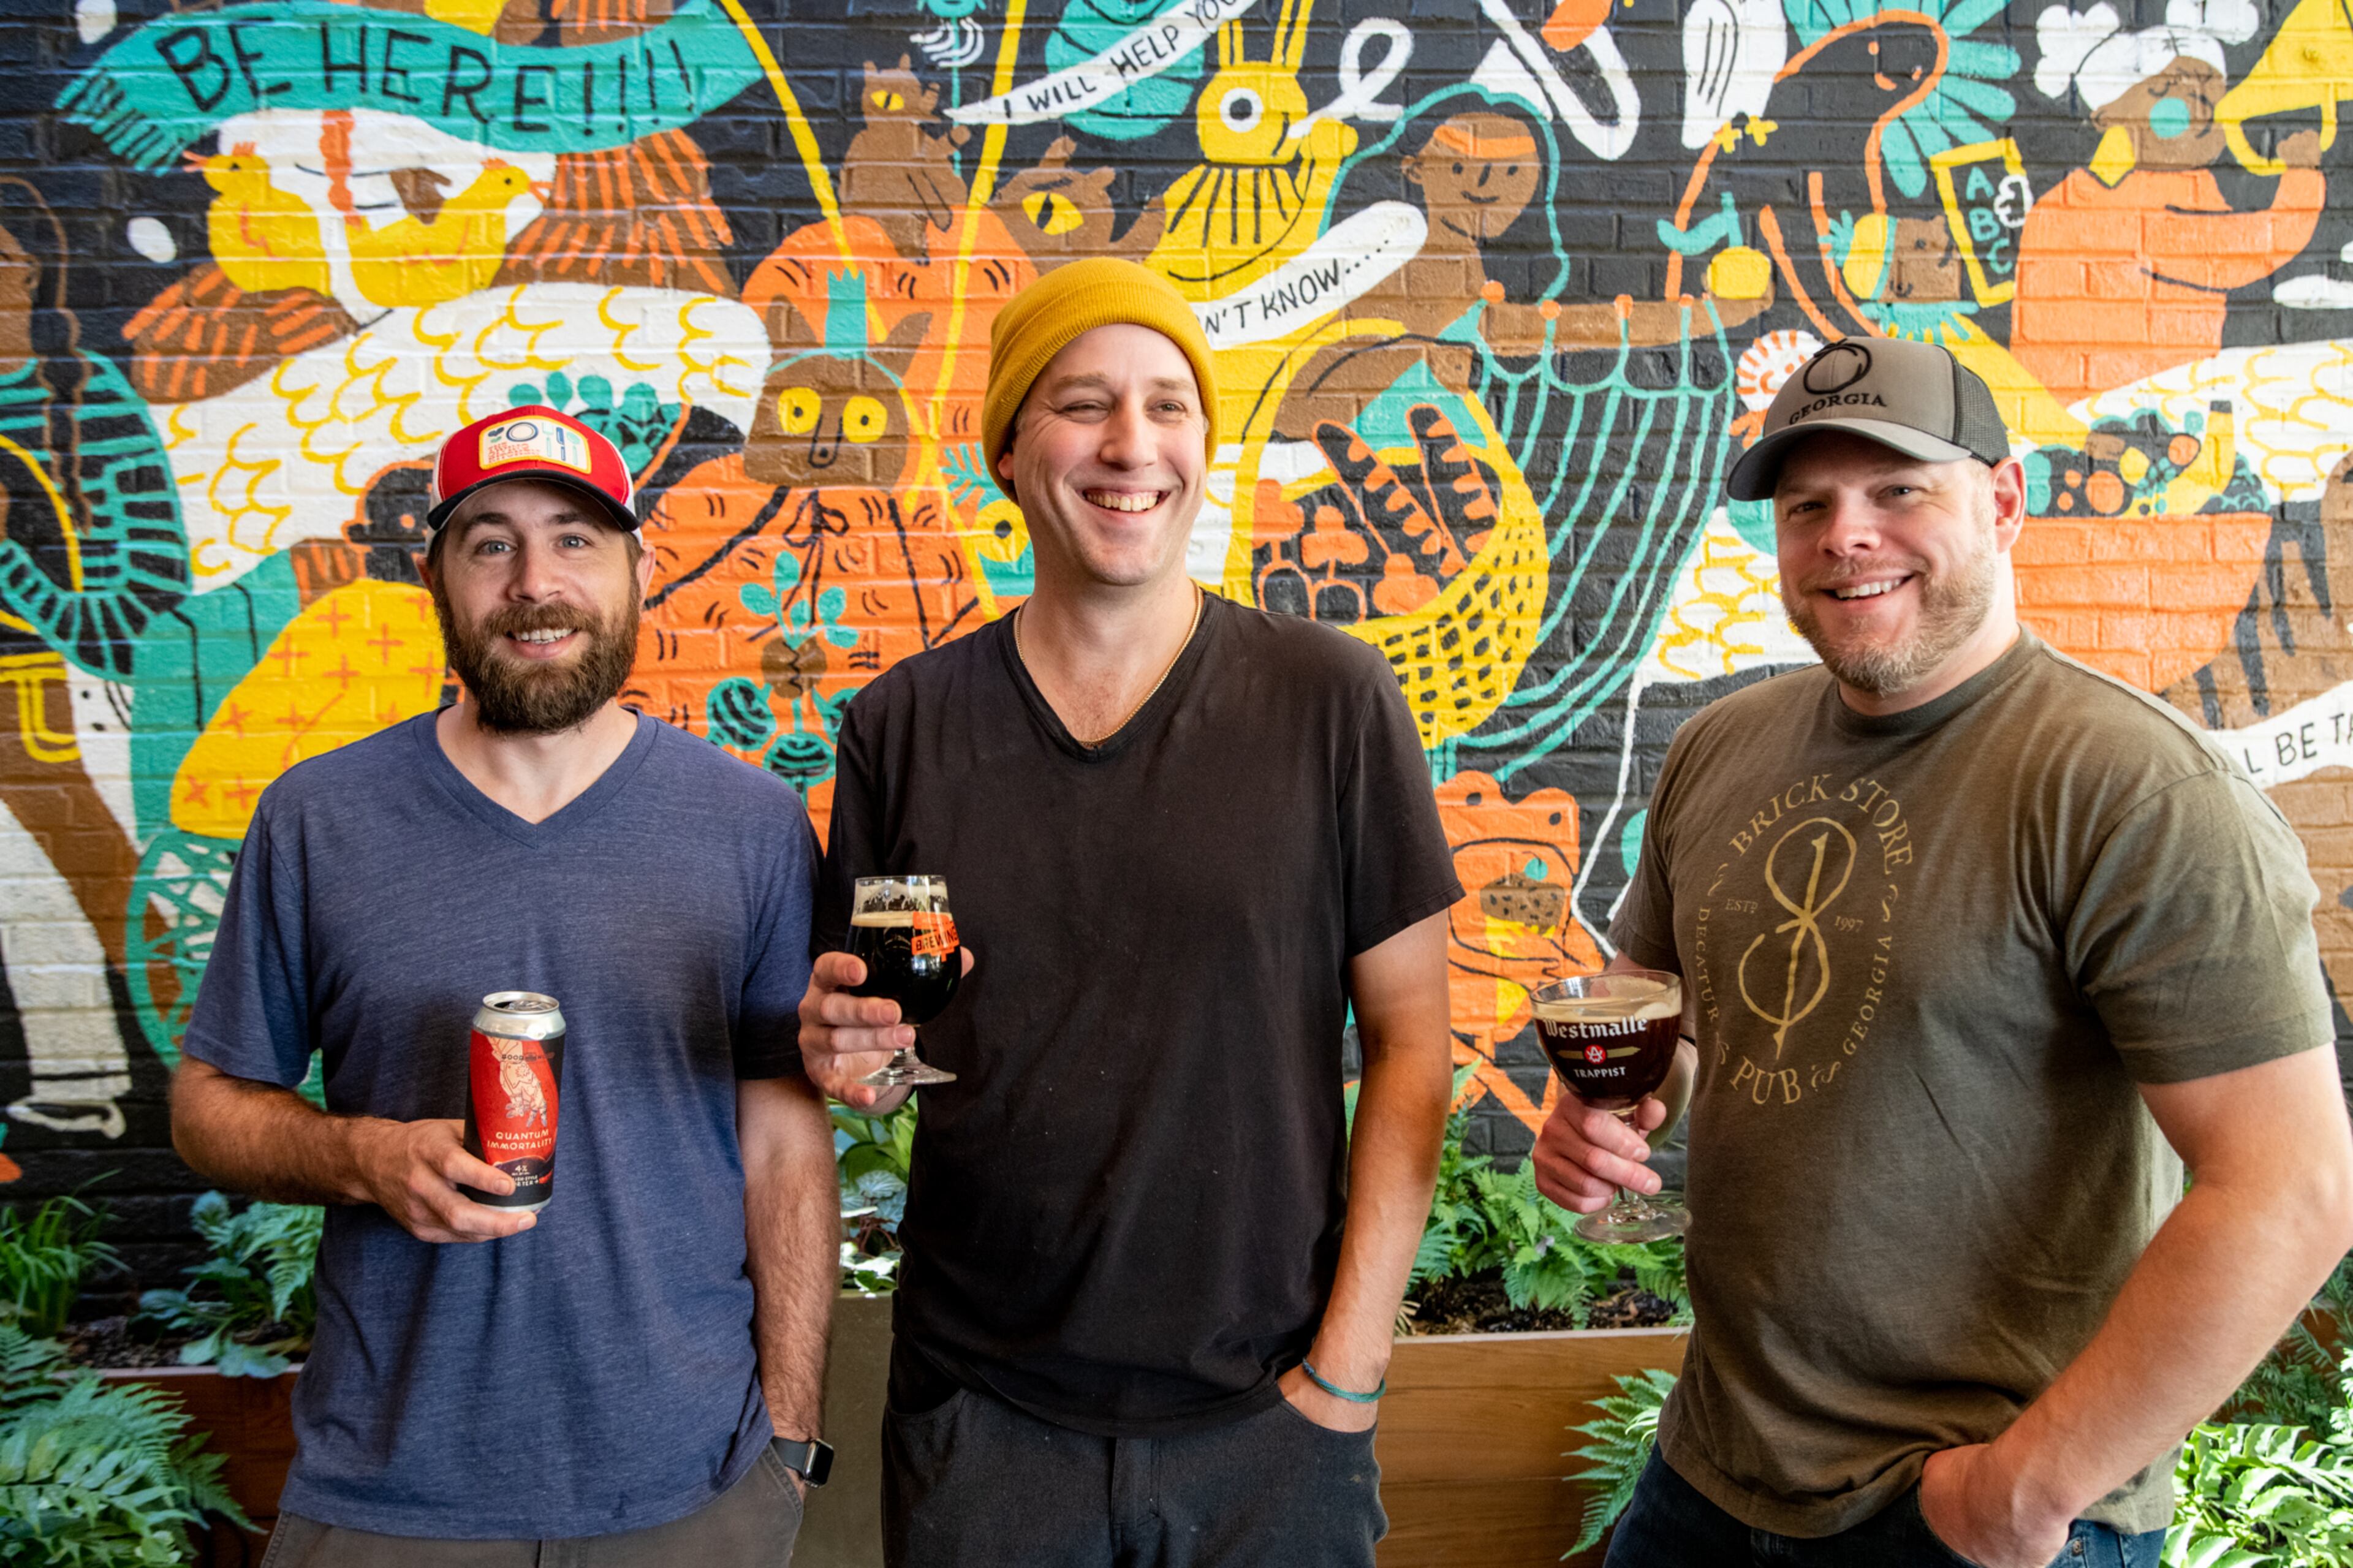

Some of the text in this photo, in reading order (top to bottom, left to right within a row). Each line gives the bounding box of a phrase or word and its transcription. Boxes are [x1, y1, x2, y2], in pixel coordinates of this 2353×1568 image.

[154, 17, 695, 136] BE HERE!!!!
[1004, 98, 1012, 119] I
[1027, 75, 1097, 112] WILL
[1109, 24, 1179, 78] HELP
[1789, 392, 1887, 425] GEORGIA
[2275, 722, 2317, 766] BE
[1728, 773, 1913, 876] BRICK STORE
[1834, 915, 1864, 933] 1997
[1696, 906, 1720, 1022] DECATUR
[1843, 936, 1893, 1056] GEORGIA
[1542, 1015, 1648, 1039] Westmalle
[1573, 1066, 1626, 1078] TRAPPIST
[1729, 1055, 1802, 1105] PUB
[487, 1138, 553, 1151] IMMORTALITY
[495, 1129, 549, 1140] QUANTUM
